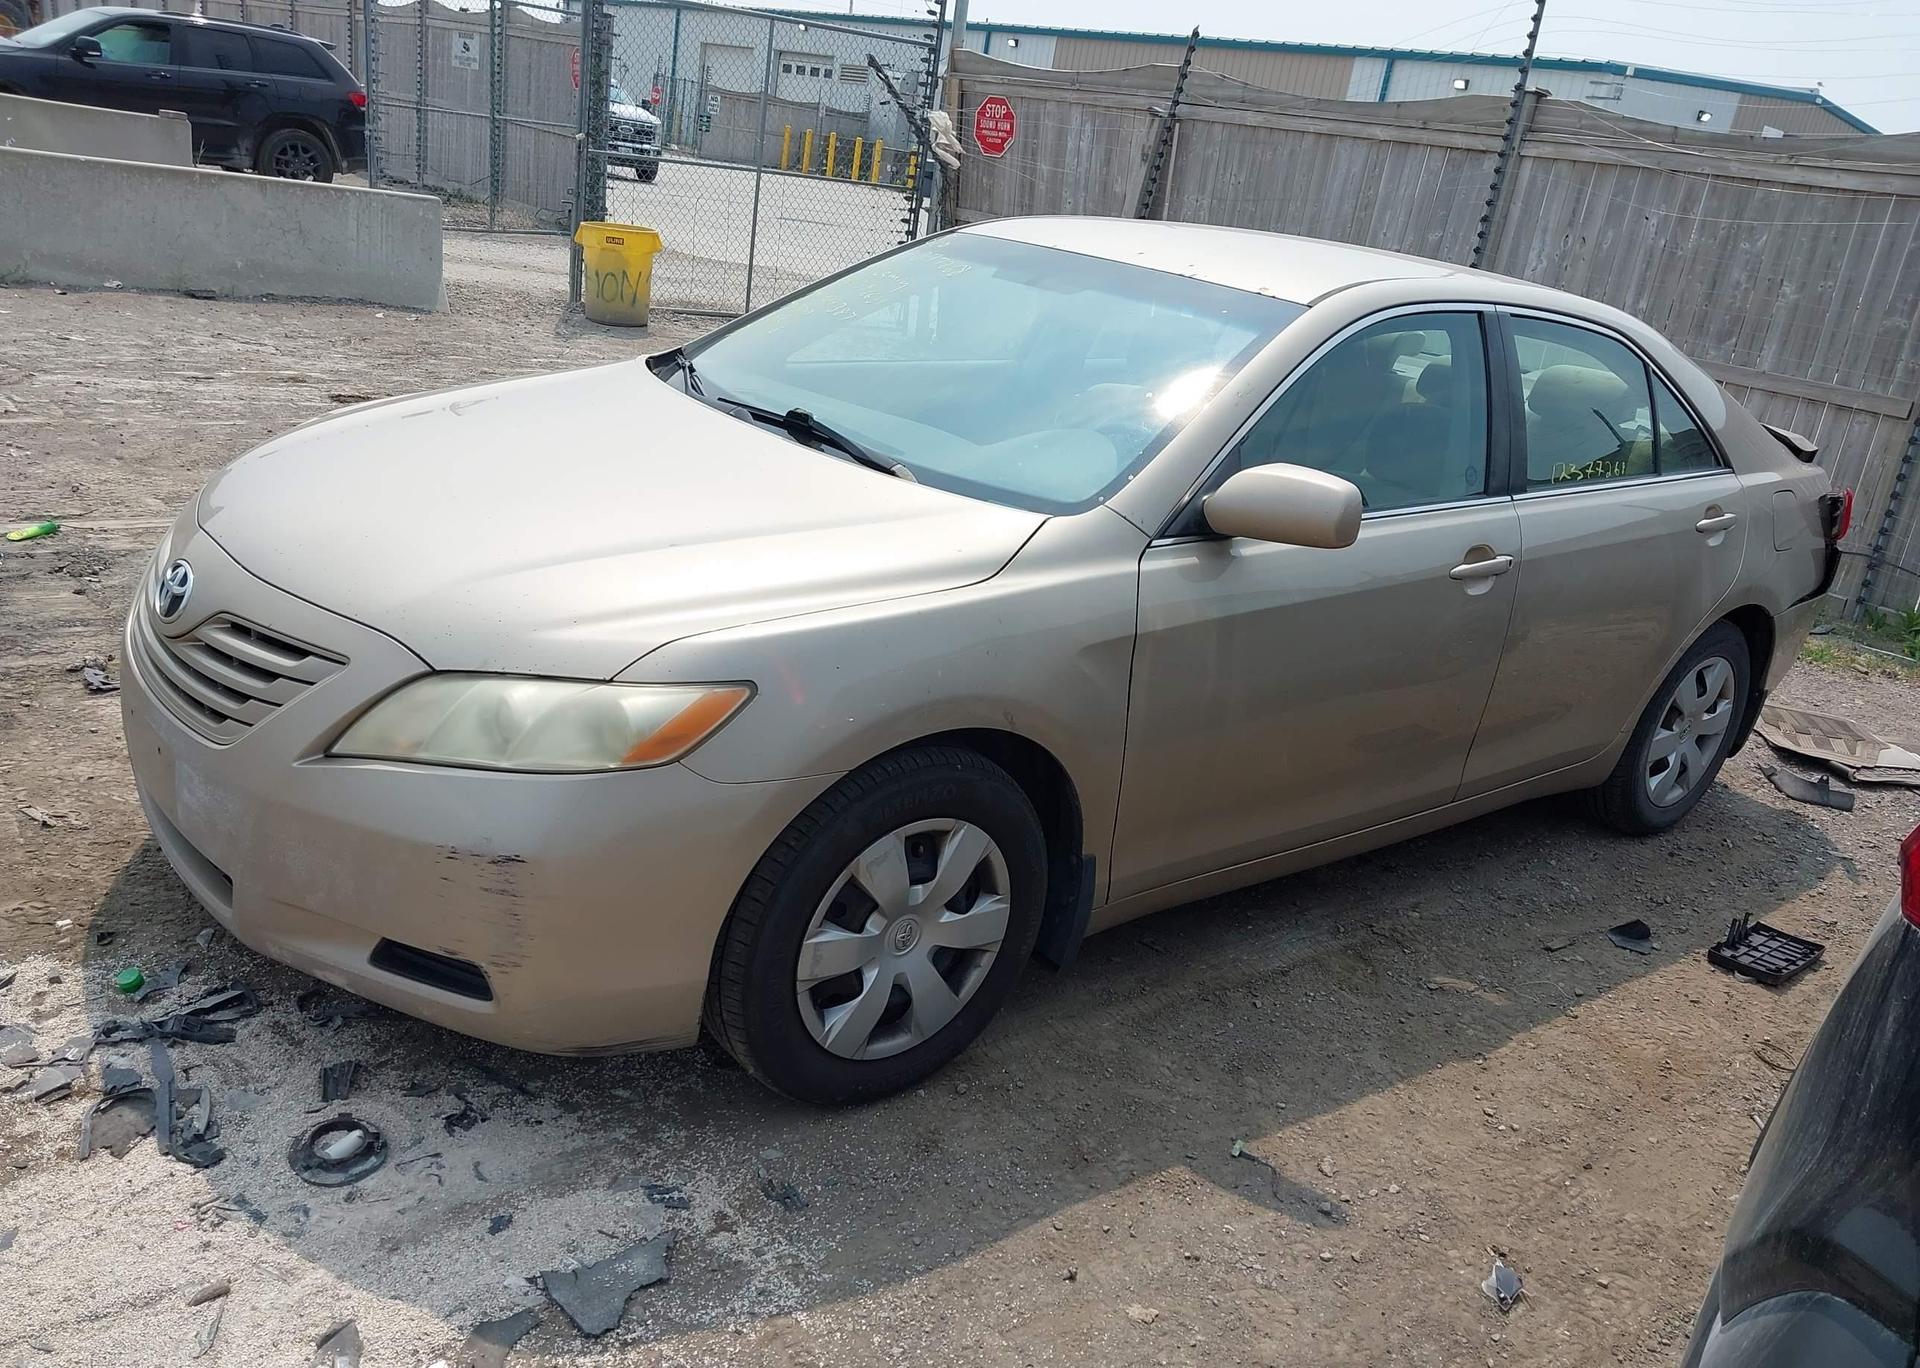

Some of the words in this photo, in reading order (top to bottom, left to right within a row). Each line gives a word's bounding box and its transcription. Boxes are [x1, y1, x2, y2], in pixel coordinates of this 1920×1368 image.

[986, 104, 1006, 118] STOP
[980, 120, 996, 129] SOUND
[998, 122, 1010, 131] HORN
